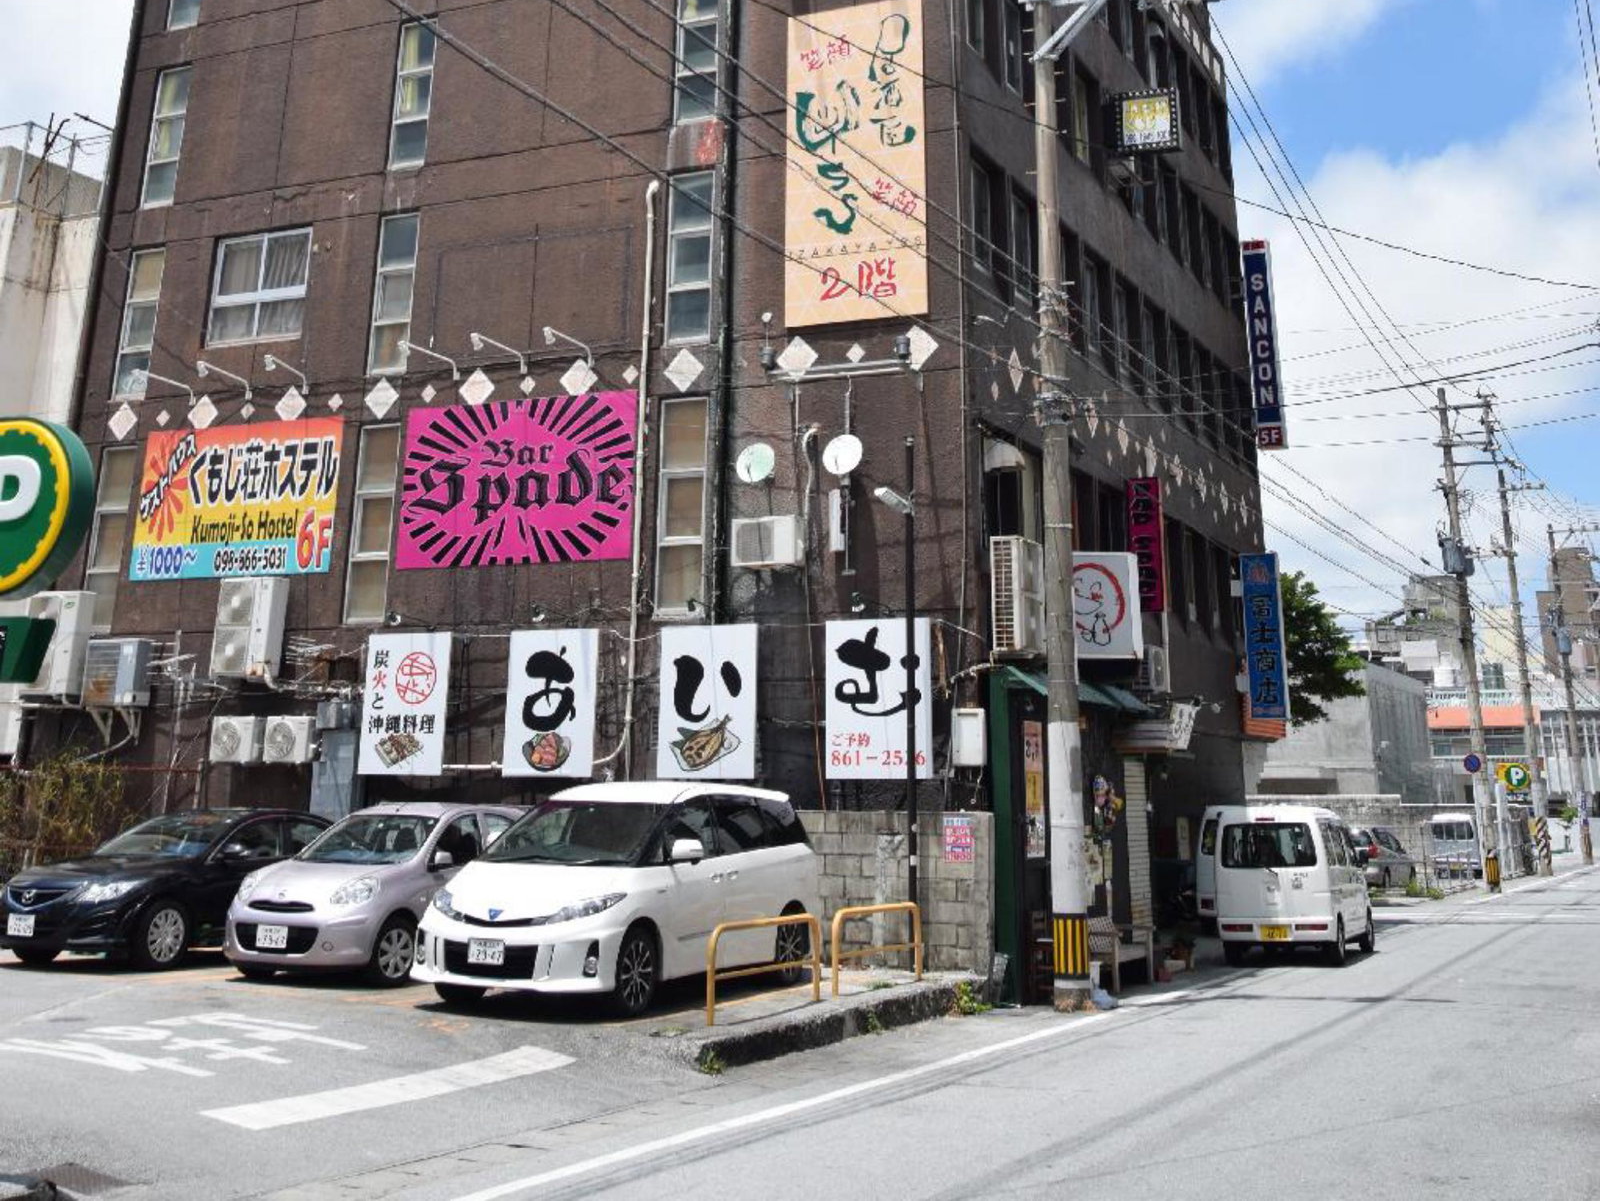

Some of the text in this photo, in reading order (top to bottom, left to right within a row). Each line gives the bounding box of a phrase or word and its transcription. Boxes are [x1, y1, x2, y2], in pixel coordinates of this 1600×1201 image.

[820, 257, 898, 300] 2階
[1251, 274, 1274, 404] SANCON
[481, 439, 554, 468] Bar
[1260, 428, 1281, 444] 5F
[190, 437, 339, 505] くもじ荘ホステル
[407, 448, 628, 526] Spade
[191, 507, 333, 570] Kumoji-So Hostel 6F
[372, 649, 390, 710] 炭火と
[368, 714, 436, 734] 沖縄料理
[831, 750, 926, 766] 861-256
